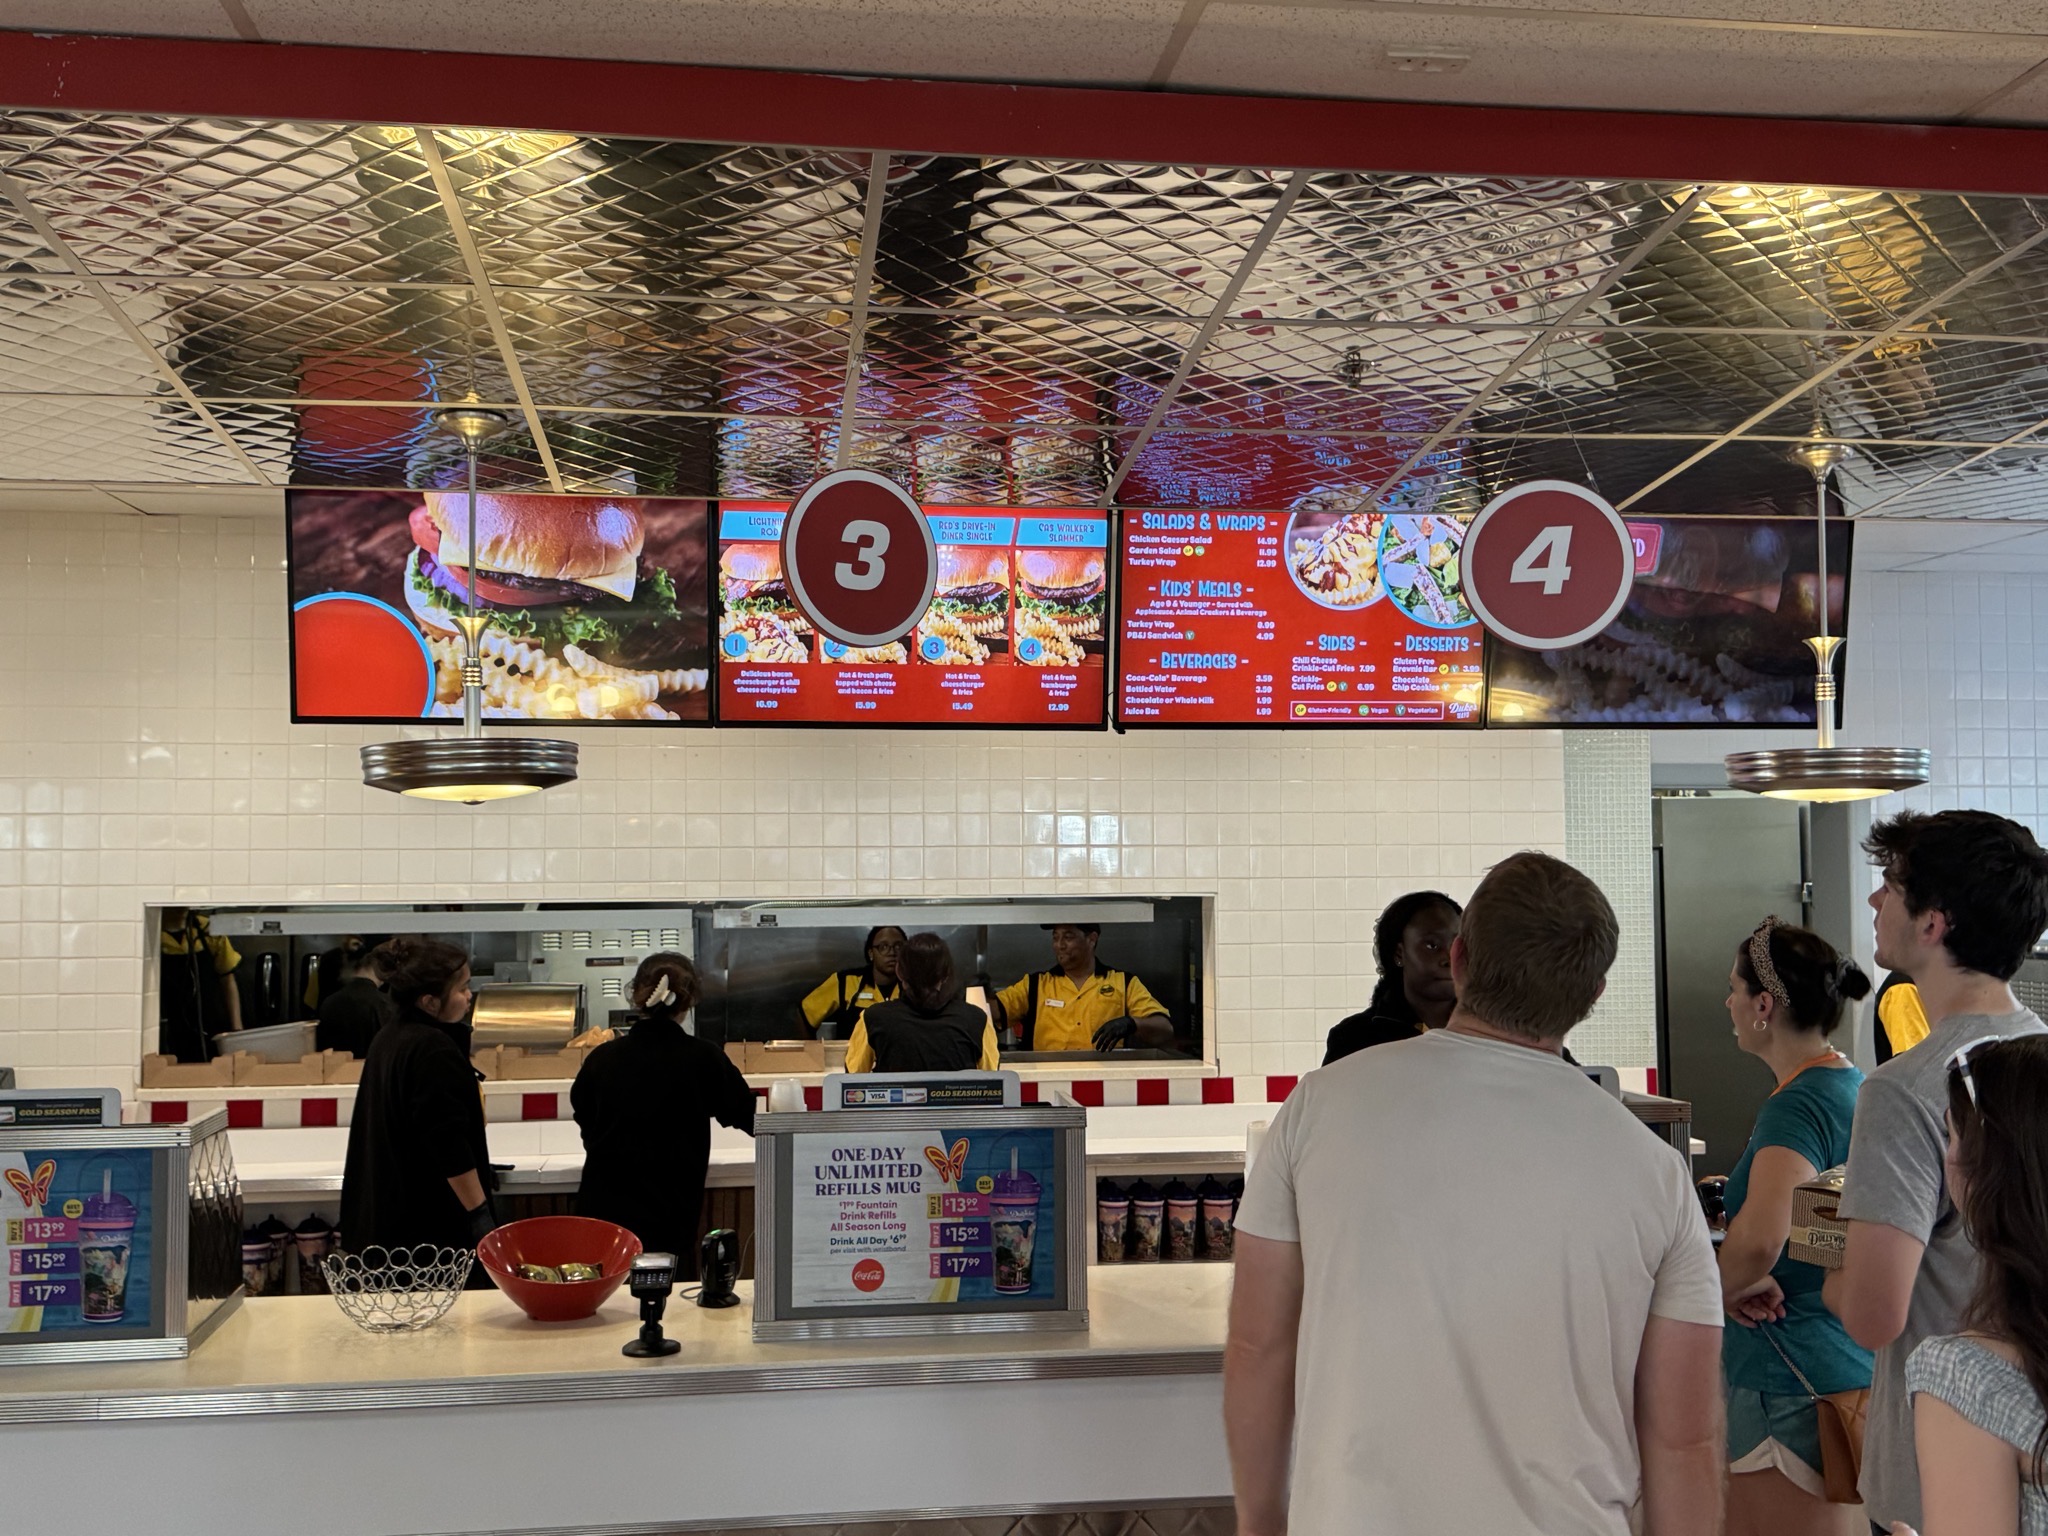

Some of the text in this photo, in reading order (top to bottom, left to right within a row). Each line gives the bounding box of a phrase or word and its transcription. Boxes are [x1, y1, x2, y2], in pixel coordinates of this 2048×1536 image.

[749, 517, 783, 526] LIGHTNI
[939, 521, 996, 531] RED'S DRIVE-IN
[1142, 512, 1265, 531] SALADS & WRAPS
[761, 528, 779, 536] ROD
[1039, 523, 1094, 533] CAS WALKER'S
[942, 532, 992, 541] DINER SINGLE
[1049, 534, 1084, 542] SLAMMER
[1129, 535, 1212, 544] Chicken Caesar Salad
[1257, 537, 1277, 545] 14.99
[835, 520, 891, 591] 3
[1129, 547, 1181, 555] Garden Salad
[1129, 558, 1176, 568] Turkey Wrap
[1257, 560, 1276, 568] 12.99
[1510, 525, 1573, 595] 4
[1161, 580, 1242, 598] KIDS' MEALS
[1179, 600, 1211, 609] Younger
[1236, 610, 1267, 618] Beverage
[1127, 621, 1175, 630] Turkey Wrap
[1147, 632, 1184, 640] Sandwich
[734, 639, 738, 651] 1
[1319, 634, 1355, 651] SIDES
[1406, 635, 1469, 652] DESSERTS
[930, 642, 940, 655] 3
[1026, 643, 1036, 656] 4
[1161, 652, 1237, 669] BEVERAGES
[1171, 675, 1207, 683] Beverage
[1154, 686, 1176, 694] Water
[1392, 684, 1410, 692] Chip
[952, 1089, 983, 1097] SEASON
[44, 1108, 78, 1116] SEASON
[832, 1147, 906, 1162] ONE-DAY
[815, 1163, 923, 1180] UNLIMITED
[816, 1181, 921, 1196] REFILLS MUG
[856, 1200, 897, 1210] Fountain
[841, 1211, 896, 1221] Drink Refills
[831, 1222, 907, 1232] All Season Long
[830, 1238, 854, 1246] Drink
[856, 1237, 868, 1245] All
[870, 1237, 888, 1246] Day
